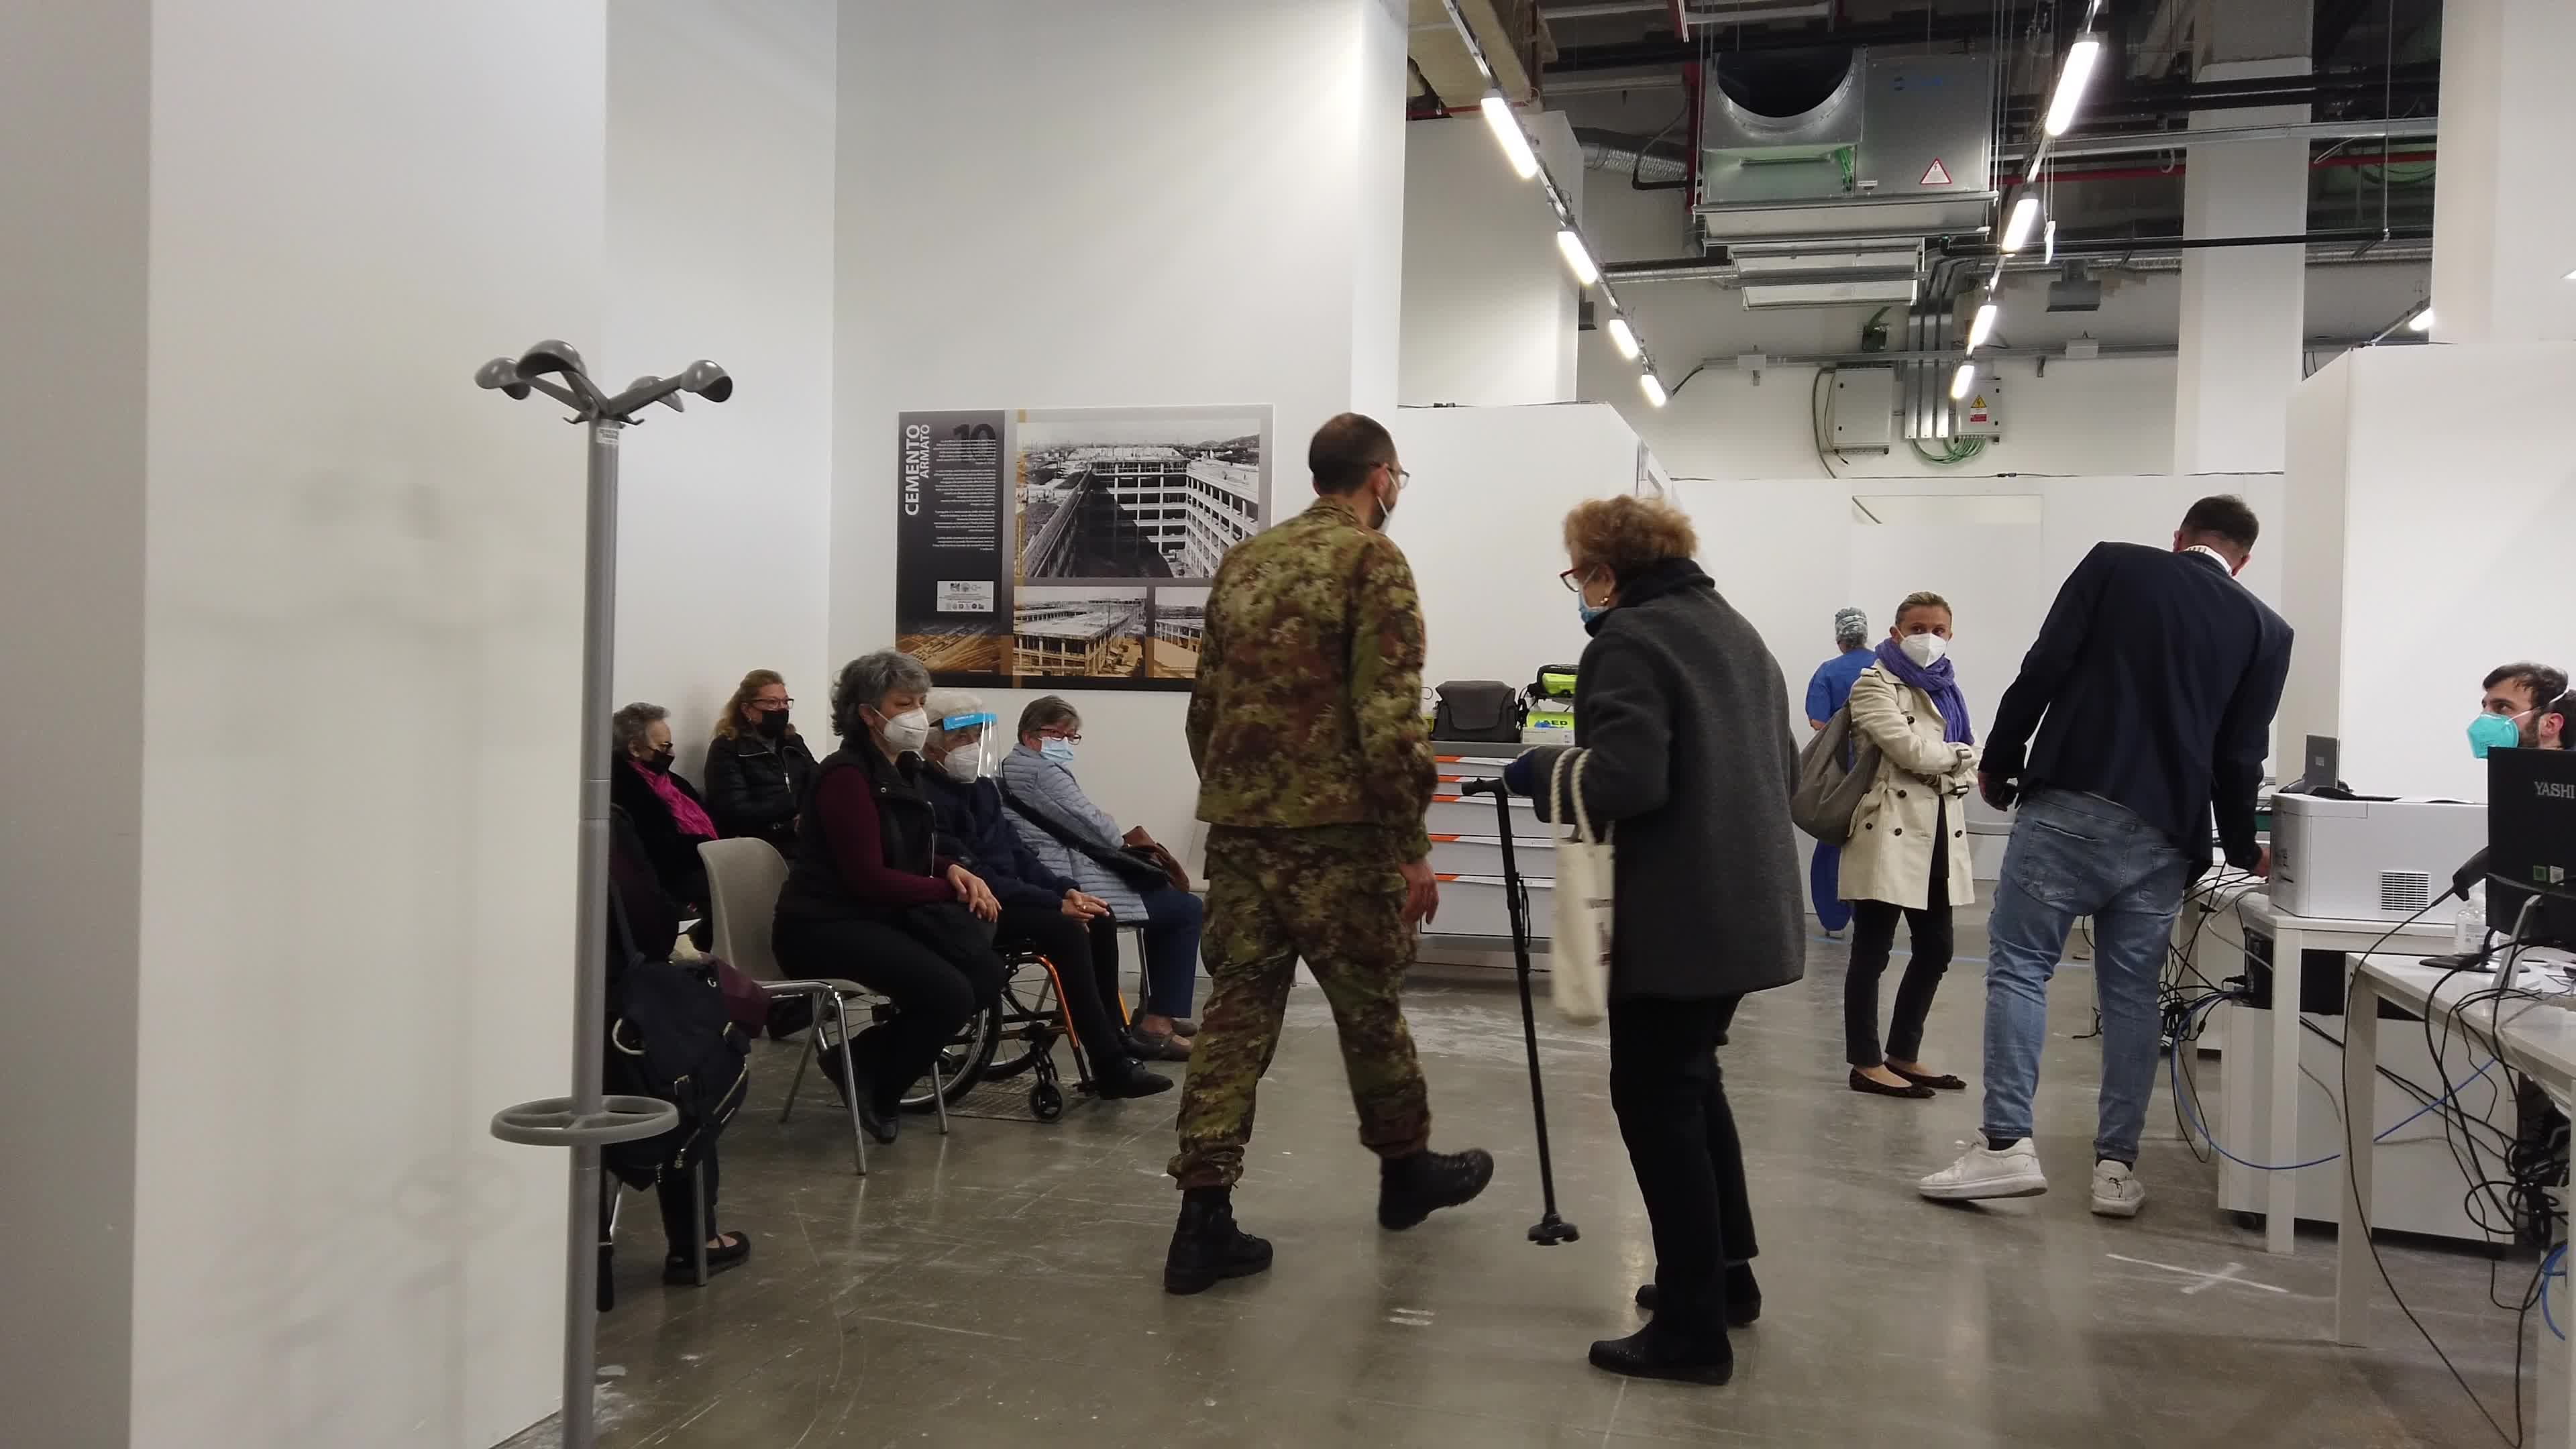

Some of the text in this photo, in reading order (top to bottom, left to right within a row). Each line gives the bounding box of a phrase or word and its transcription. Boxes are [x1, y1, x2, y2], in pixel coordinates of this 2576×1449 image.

[905, 424, 920, 516] CEMENTO
[920, 424, 930, 478] ARMATO
[2534, 781, 2575, 799] YASHI
